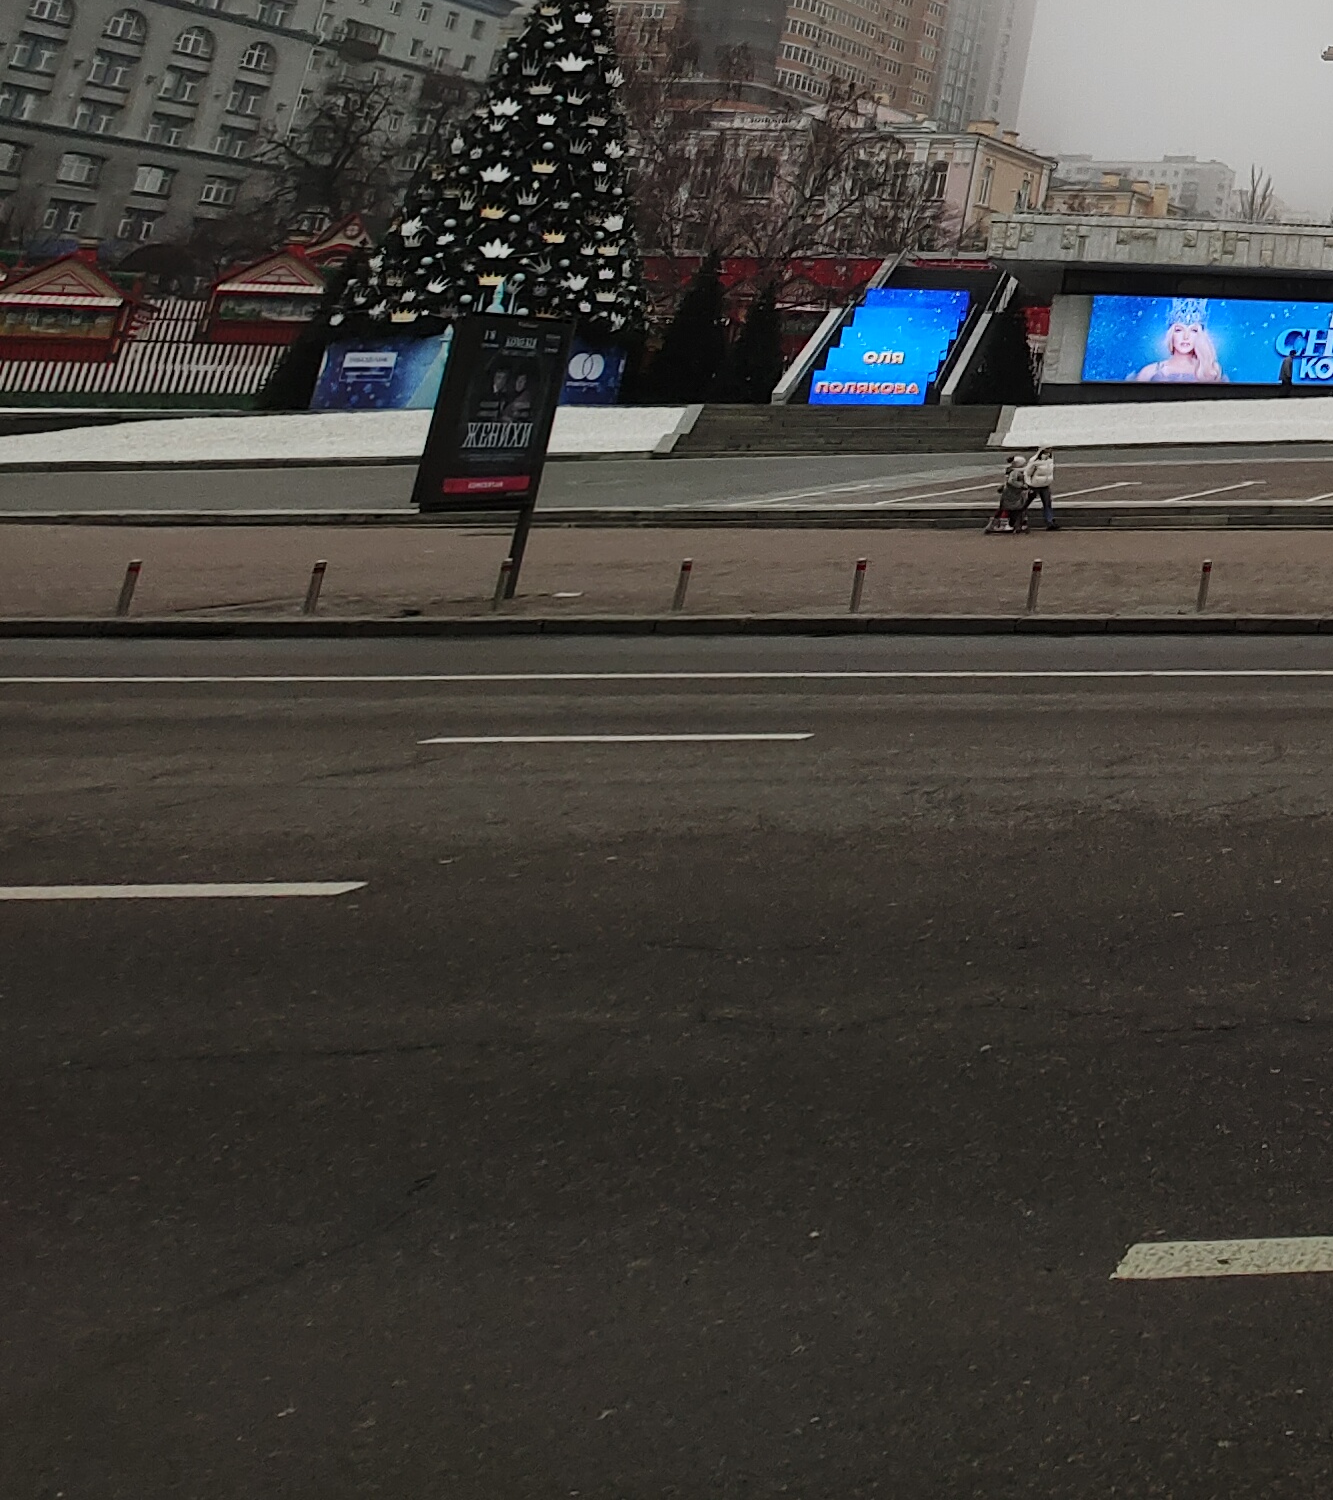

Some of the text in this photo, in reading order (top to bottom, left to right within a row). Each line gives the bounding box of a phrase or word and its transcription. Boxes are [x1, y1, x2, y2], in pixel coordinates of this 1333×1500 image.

[863, 350, 905, 365] ОЛЯ
[815, 381, 920, 395] ПОЛЯКОВА
[460, 422, 534, 448] ЖЕНИХИ
